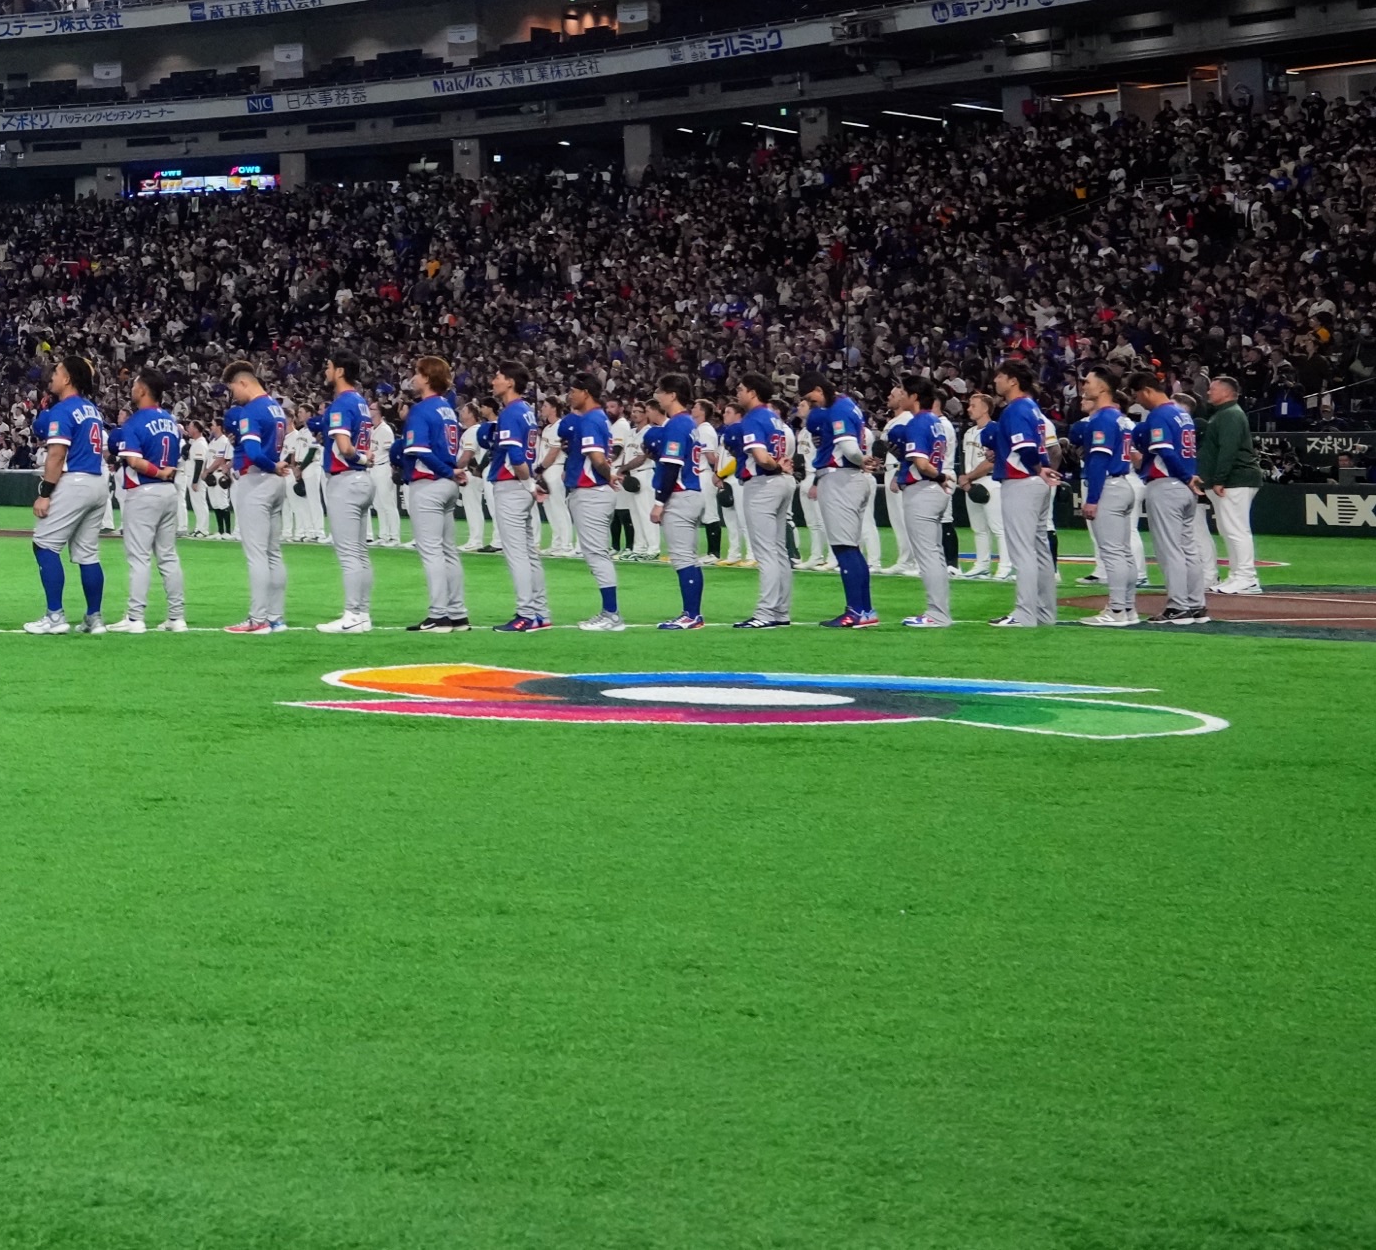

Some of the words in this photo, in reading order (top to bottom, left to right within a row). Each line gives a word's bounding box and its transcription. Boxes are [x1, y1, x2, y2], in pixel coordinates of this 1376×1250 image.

[249, 97, 273, 110] NJC
[286, 89, 367, 110] 日本事務器
[89, 422, 102, 455] 4
[160, 436, 170, 468] 1
